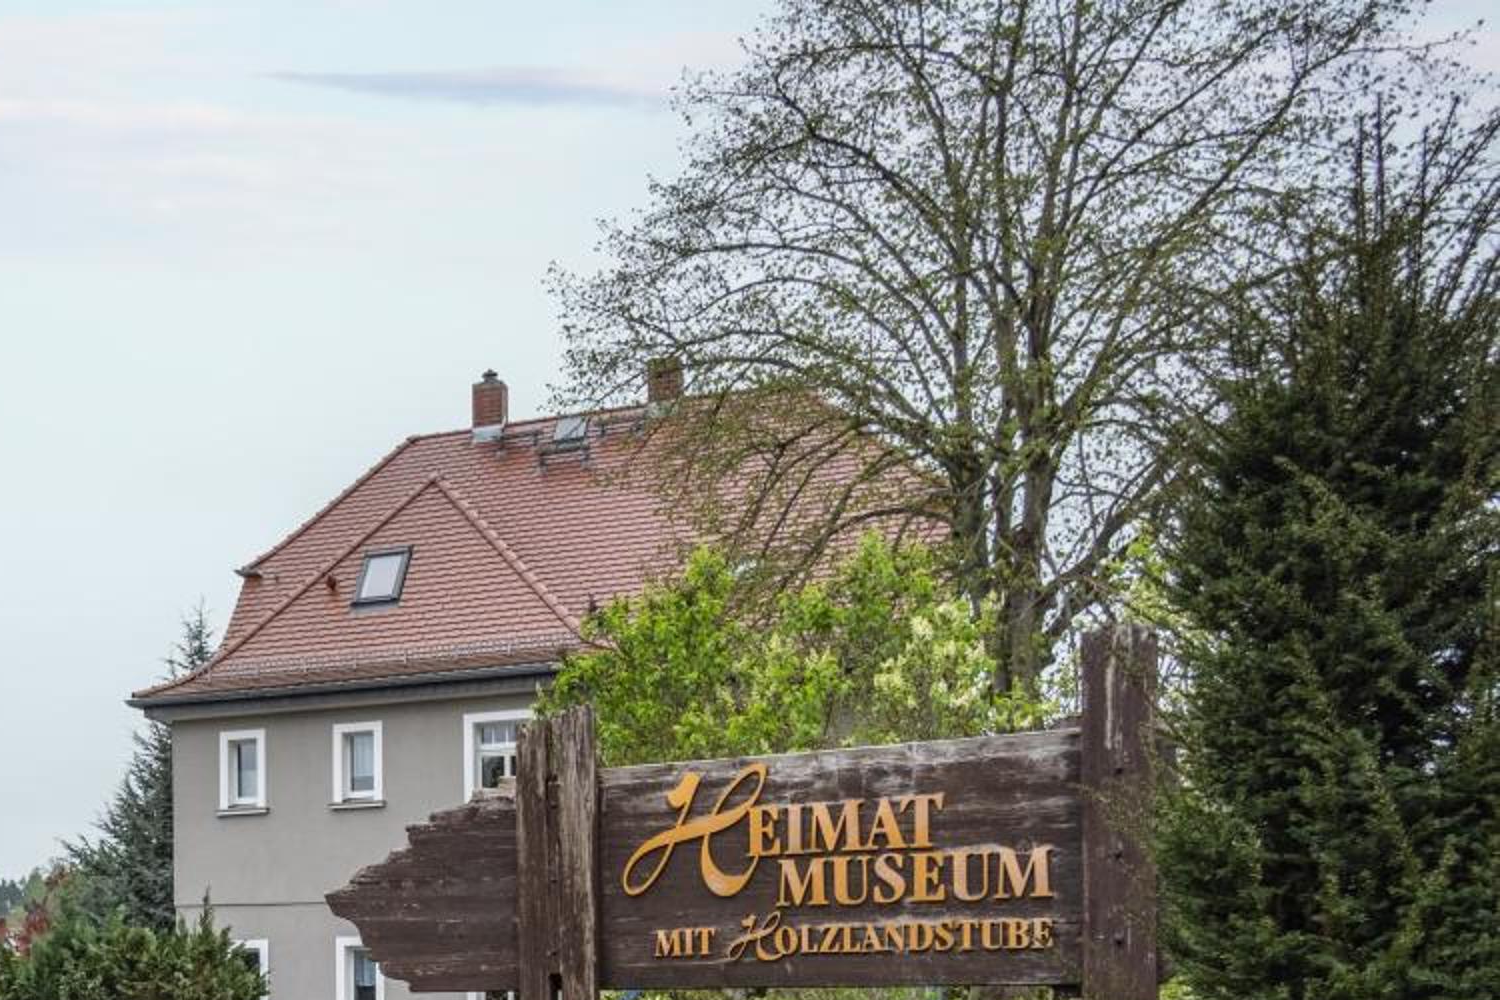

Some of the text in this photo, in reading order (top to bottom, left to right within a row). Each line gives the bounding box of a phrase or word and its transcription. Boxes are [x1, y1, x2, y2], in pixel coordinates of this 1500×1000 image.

[622, 762, 945, 897] HEIMAT
[775, 844, 1055, 907] MUSEUM
[654, 910, 1054, 962] MIT HOLZLANDSTUBE
